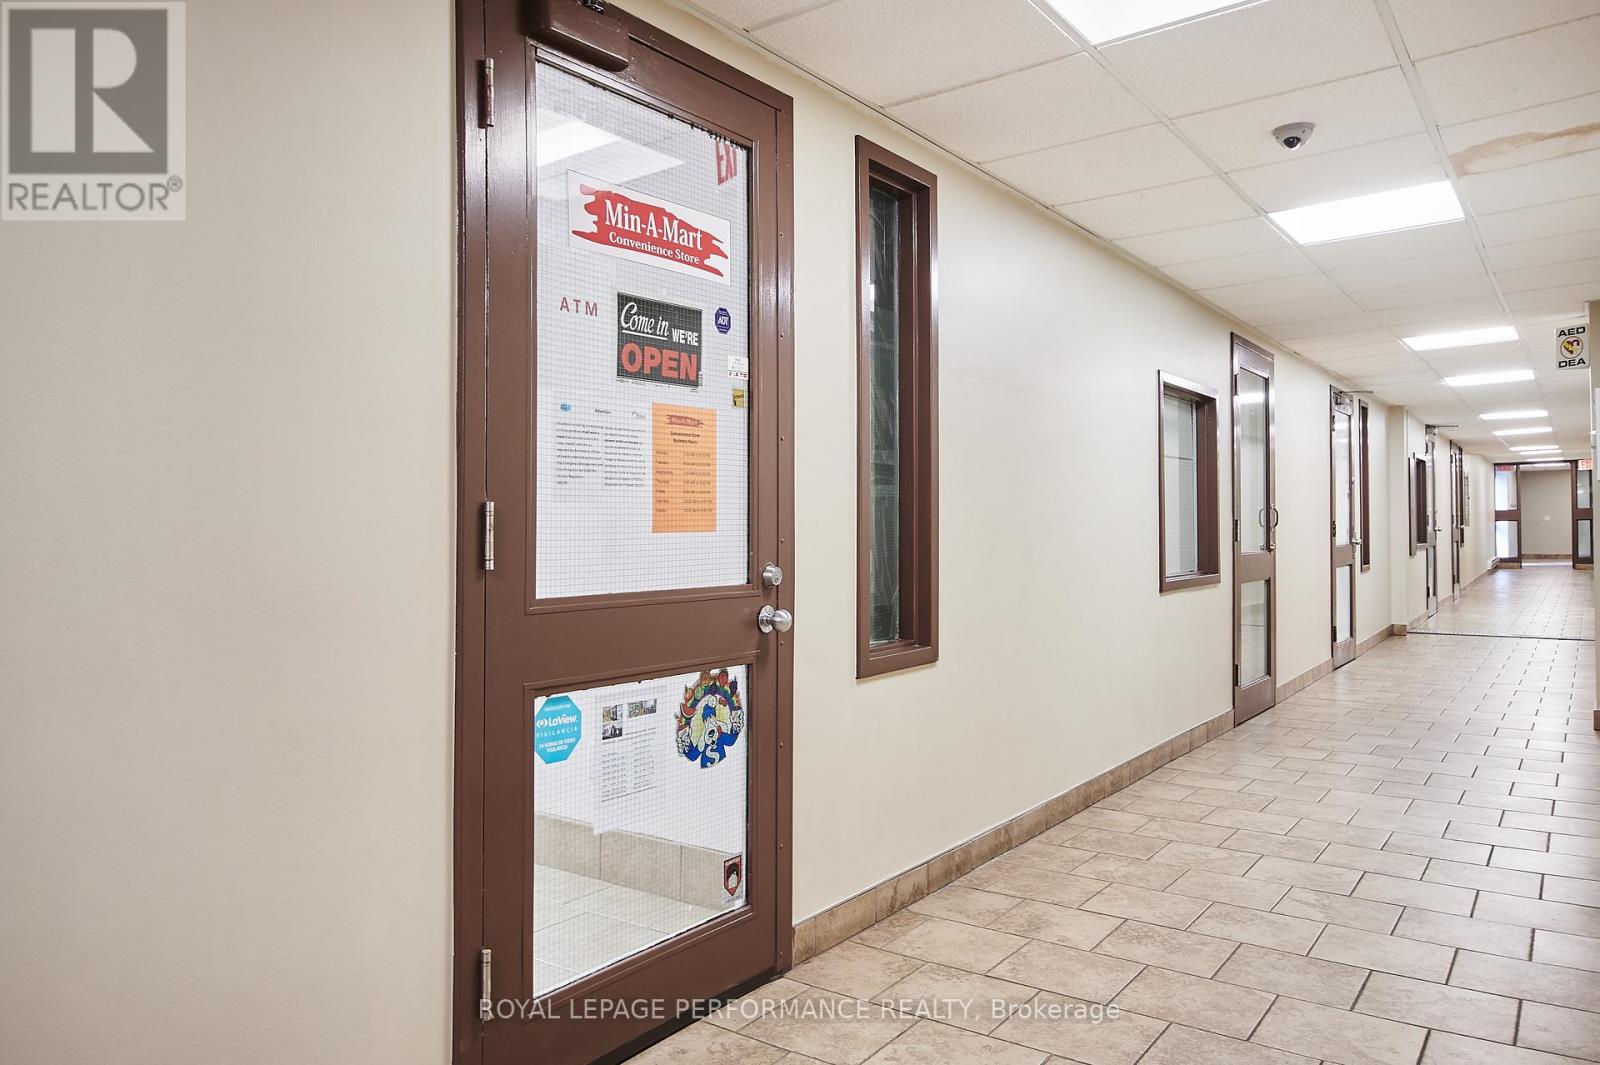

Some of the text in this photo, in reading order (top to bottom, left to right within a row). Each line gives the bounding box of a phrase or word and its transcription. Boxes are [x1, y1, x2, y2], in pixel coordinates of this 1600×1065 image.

[604, 199, 703, 250] Min-A-Mart
[608, 231, 700, 265] Convenience Store
[620, 302, 699, 346] Come in WE'RE
[1558, 326, 1586, 338] AED
[621, 342, 698, 381] OPEN
[1558, 357, 1586, 368] DEA
[548, 713, 577, 727] LaView
